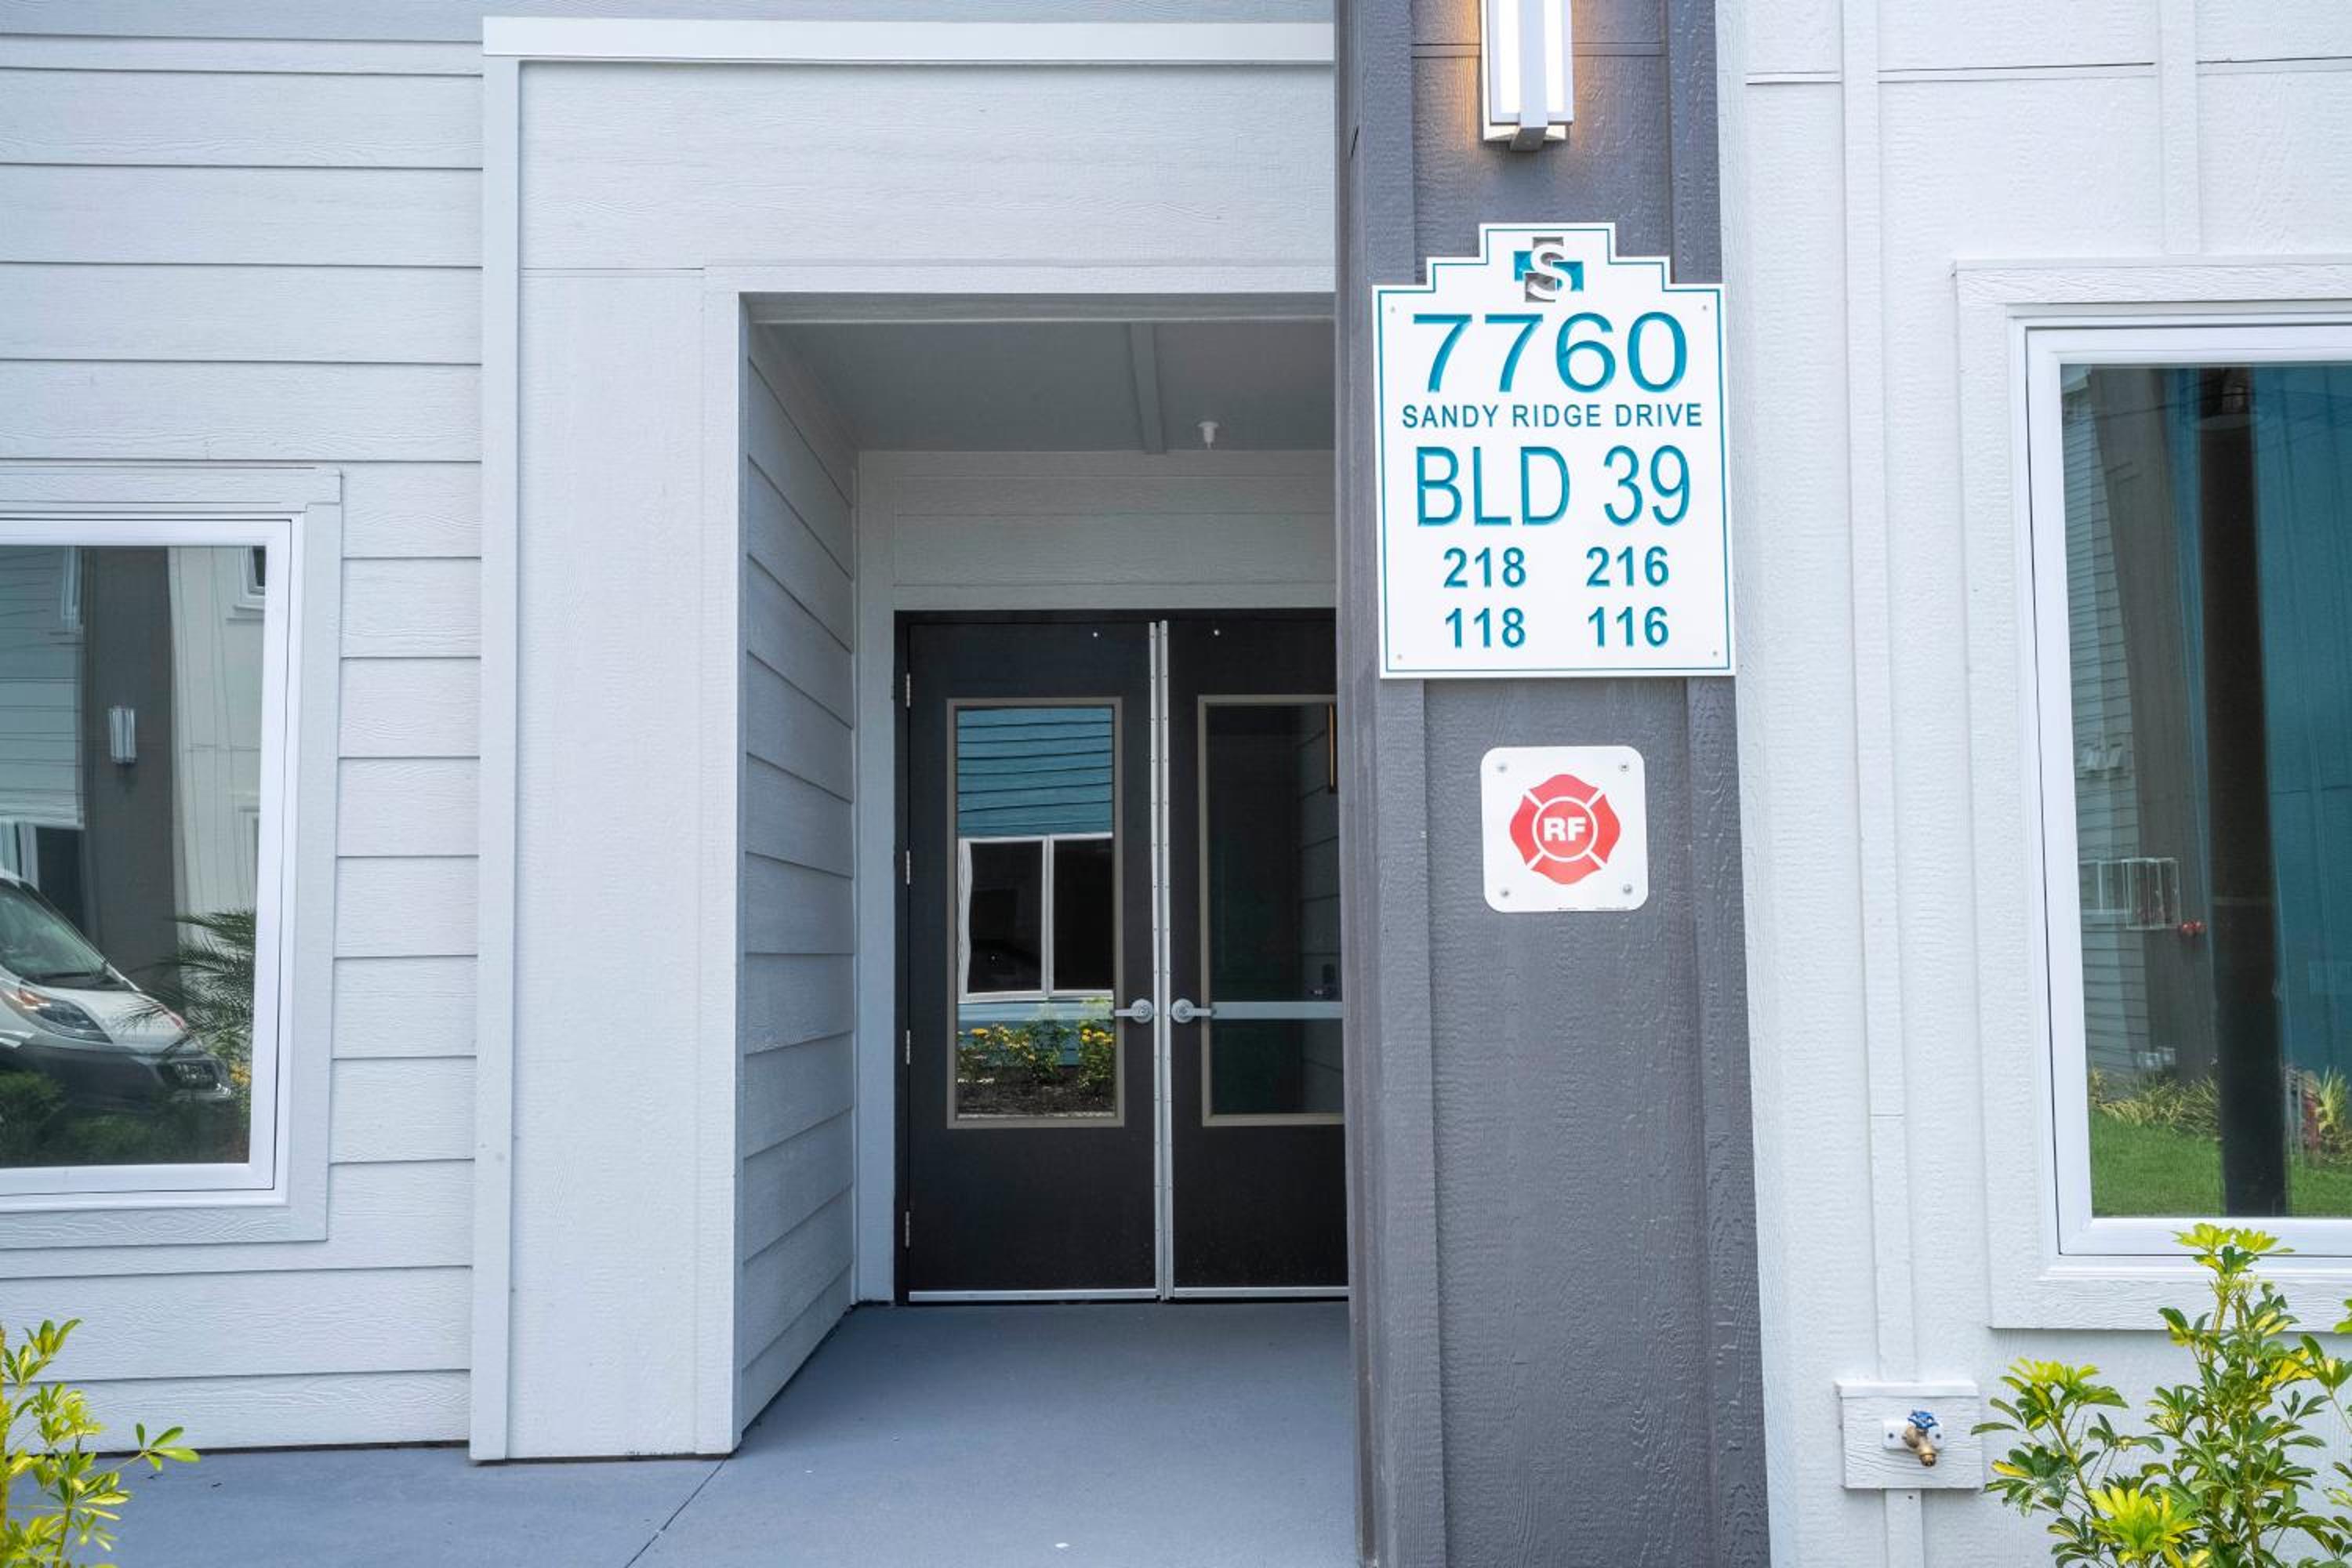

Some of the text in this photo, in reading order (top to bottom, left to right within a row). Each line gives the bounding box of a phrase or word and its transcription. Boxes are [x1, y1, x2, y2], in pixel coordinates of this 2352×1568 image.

[1527, 243, 1573, 301] S
[1413, 311, 1687, 394] 7760
[1403, 402, 1702, 429] SANDY RIDGE DRIVE
[1416, 445, 1691, 527] BLD 39
[1443, 546, 1670, 588] 218 216
[1445, 606, 1669, 648] 118 116
[1543, 817, 1588, 841] RF
